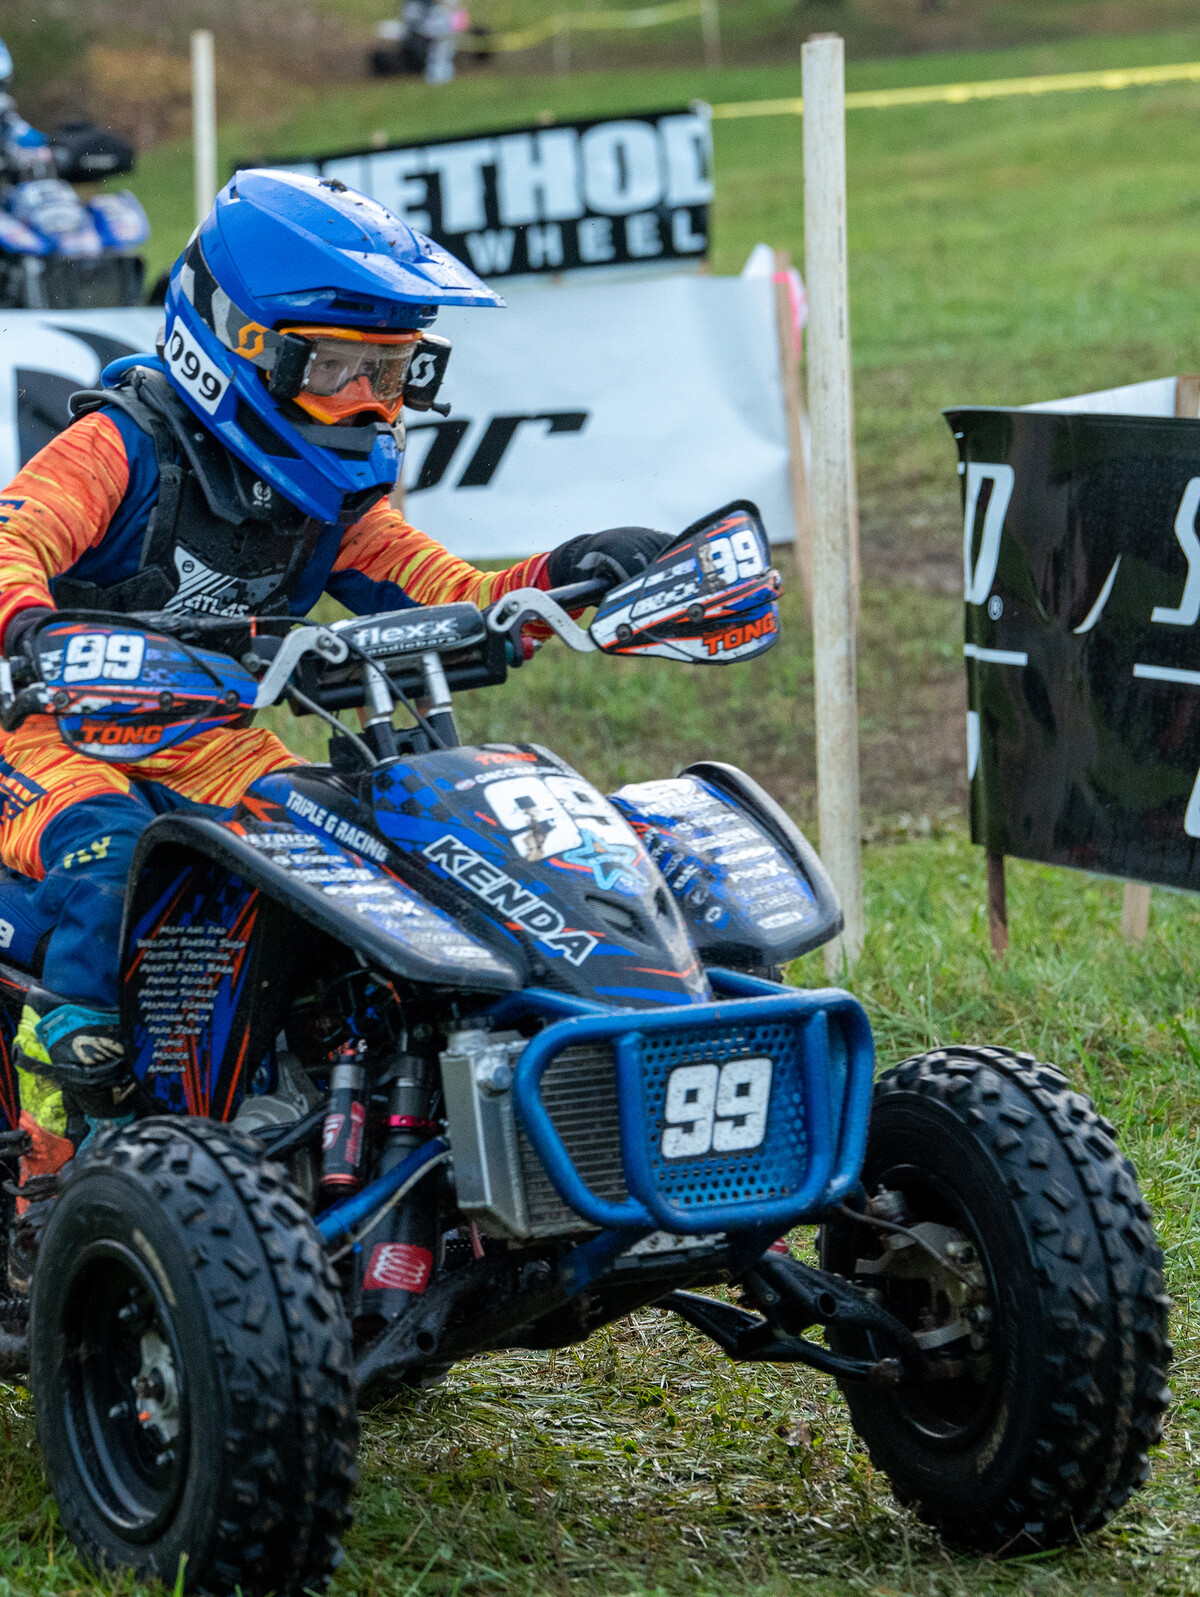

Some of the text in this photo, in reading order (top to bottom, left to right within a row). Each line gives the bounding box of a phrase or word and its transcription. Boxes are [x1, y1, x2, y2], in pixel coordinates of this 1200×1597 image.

[169, 331, 222, 401] 099
[699, 529, 765, 586] 99
[183, 593, 250, 618] ATLAS
[702, 612, 776, 656] TONG
[62, 633, 146, 683] 99
[80, 724, 165, 745] TONG
[286, 789, 328, 828] TRIPLE
[323, 814, 340, 835] G
[334, 820, 390, 864] RACING
[421, 833, 600, 968] KENDA
[661, 1057, 774, 1160] 99
